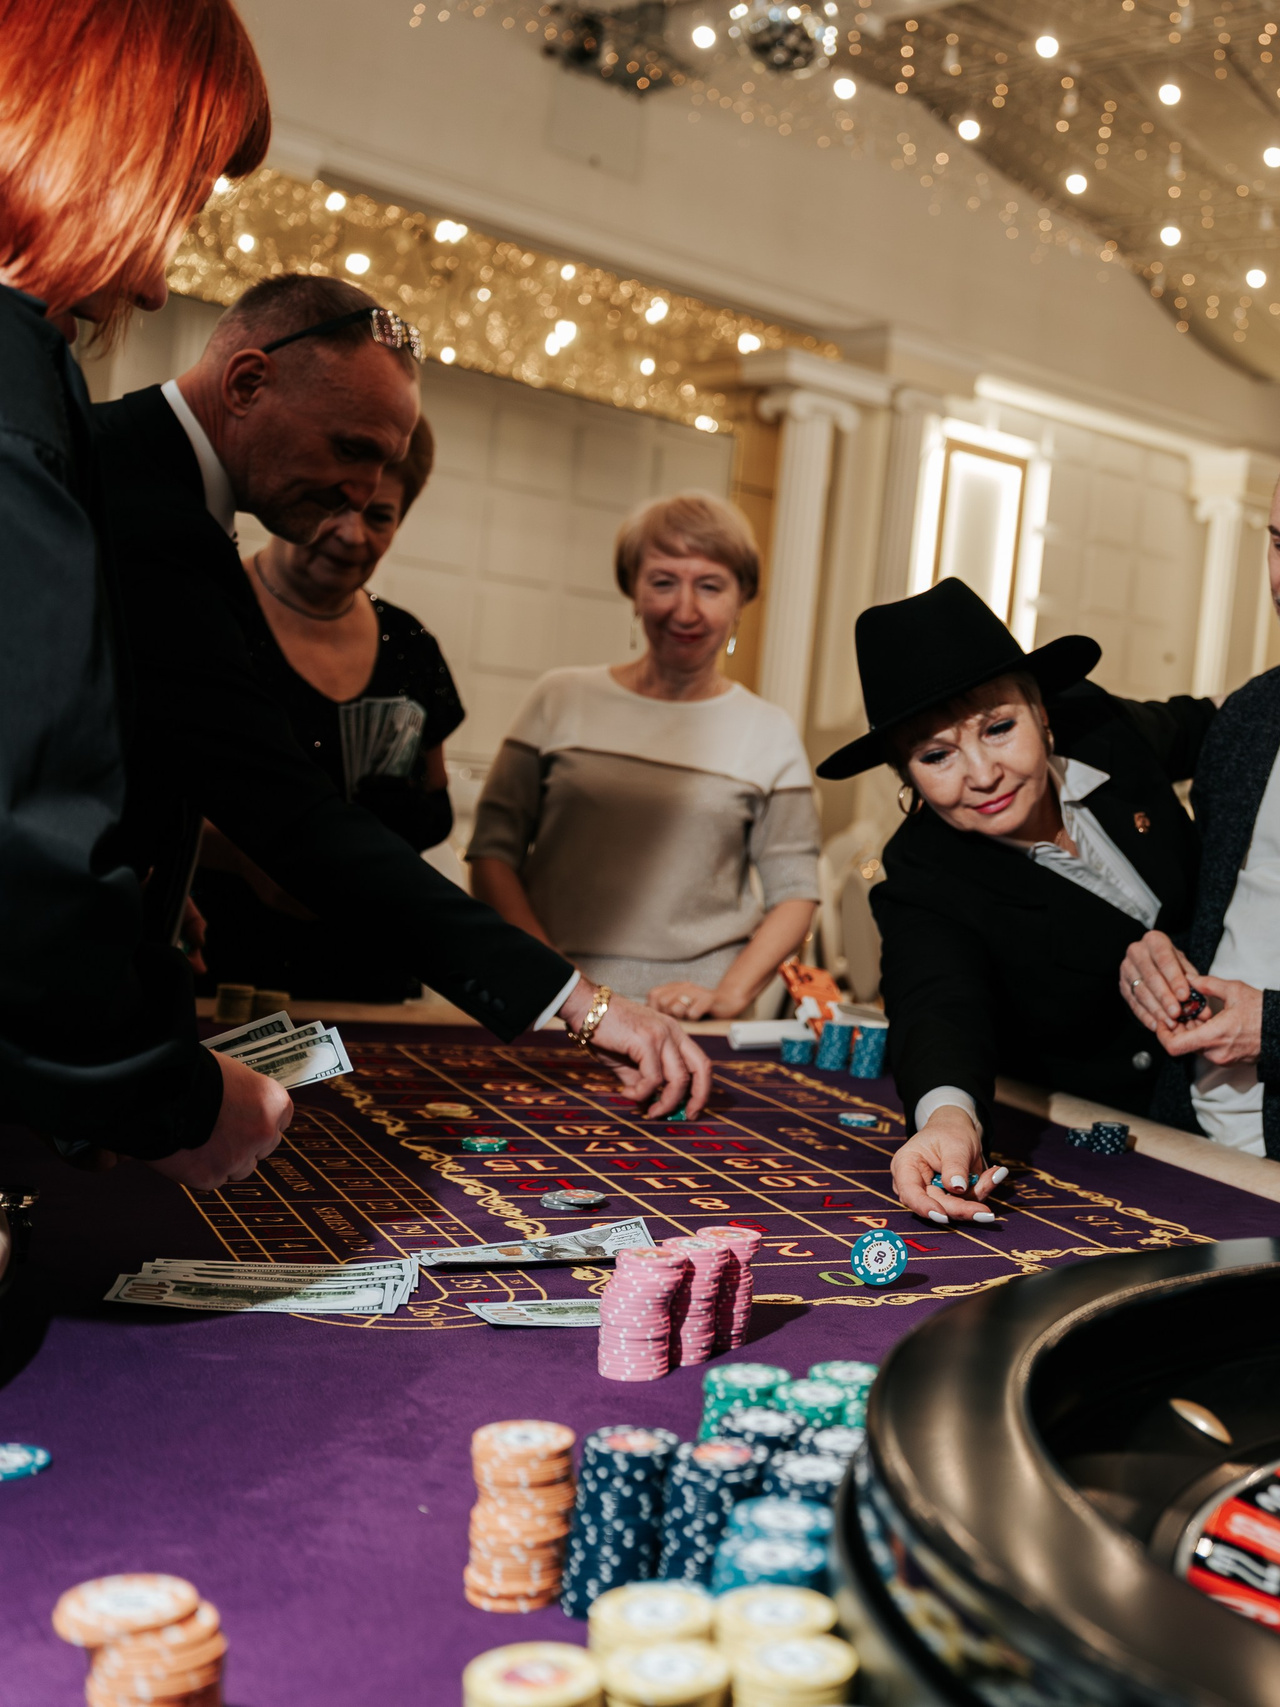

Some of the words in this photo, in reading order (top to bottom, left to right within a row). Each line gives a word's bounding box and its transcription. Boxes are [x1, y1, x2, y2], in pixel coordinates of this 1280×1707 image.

[554, 1125, 620, 1136] 20
[665, 1125, 727, 1136] 19
[584, 1141, 649, 1152] 17
[692, 1141, 757, 1151] 16
[482, 1159, 559, 1172] 15
[609, 1158, 681, 1170] 14
[723, 1157, 794, 1170] 13
[507, 1178, 589, 1191] 12
[633, 1176, 712, 1190] 11
[758, 1175, 831, 1188] 10
[688, 1197, 731, 1211] 8
[822, 1195, 855, 1208] 7
[848, 1215, 888, 1229] 4
[762, 1241, 815, 1257] 2
[873, 1250, 887, 1265] 50
[817, 1271, 866, 1287] 0
